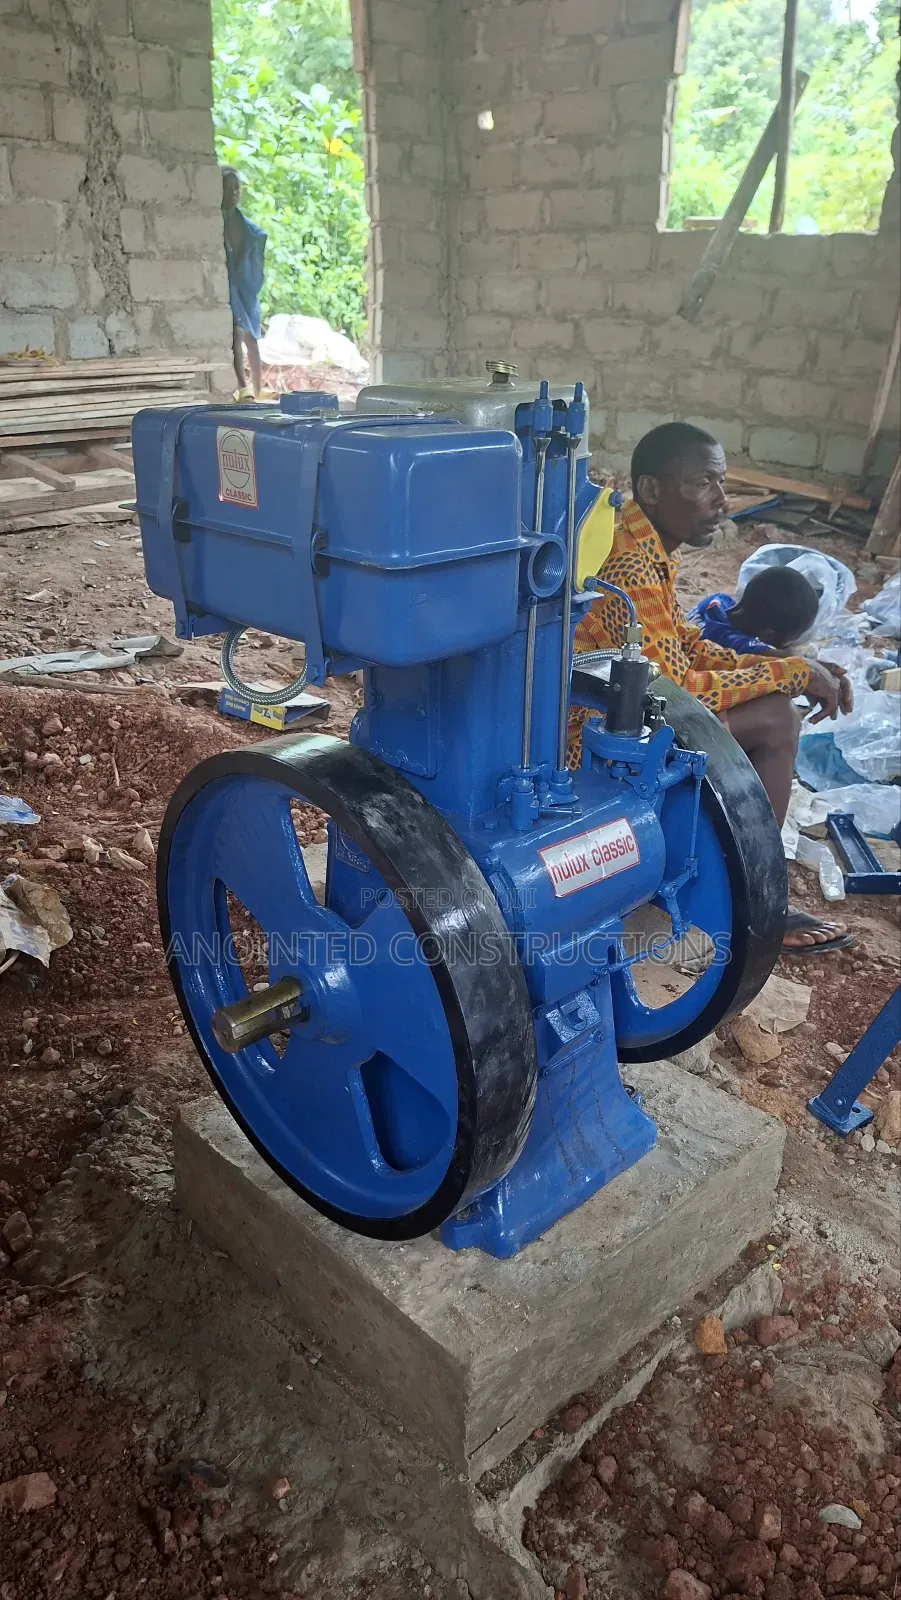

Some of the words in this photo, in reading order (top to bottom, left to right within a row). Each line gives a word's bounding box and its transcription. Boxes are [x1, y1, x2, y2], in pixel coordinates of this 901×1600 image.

[222, 449, 250, 472] nulux
[226, 488, 252, 501] CLASSIC
[591, 830, 635, 867] classic
